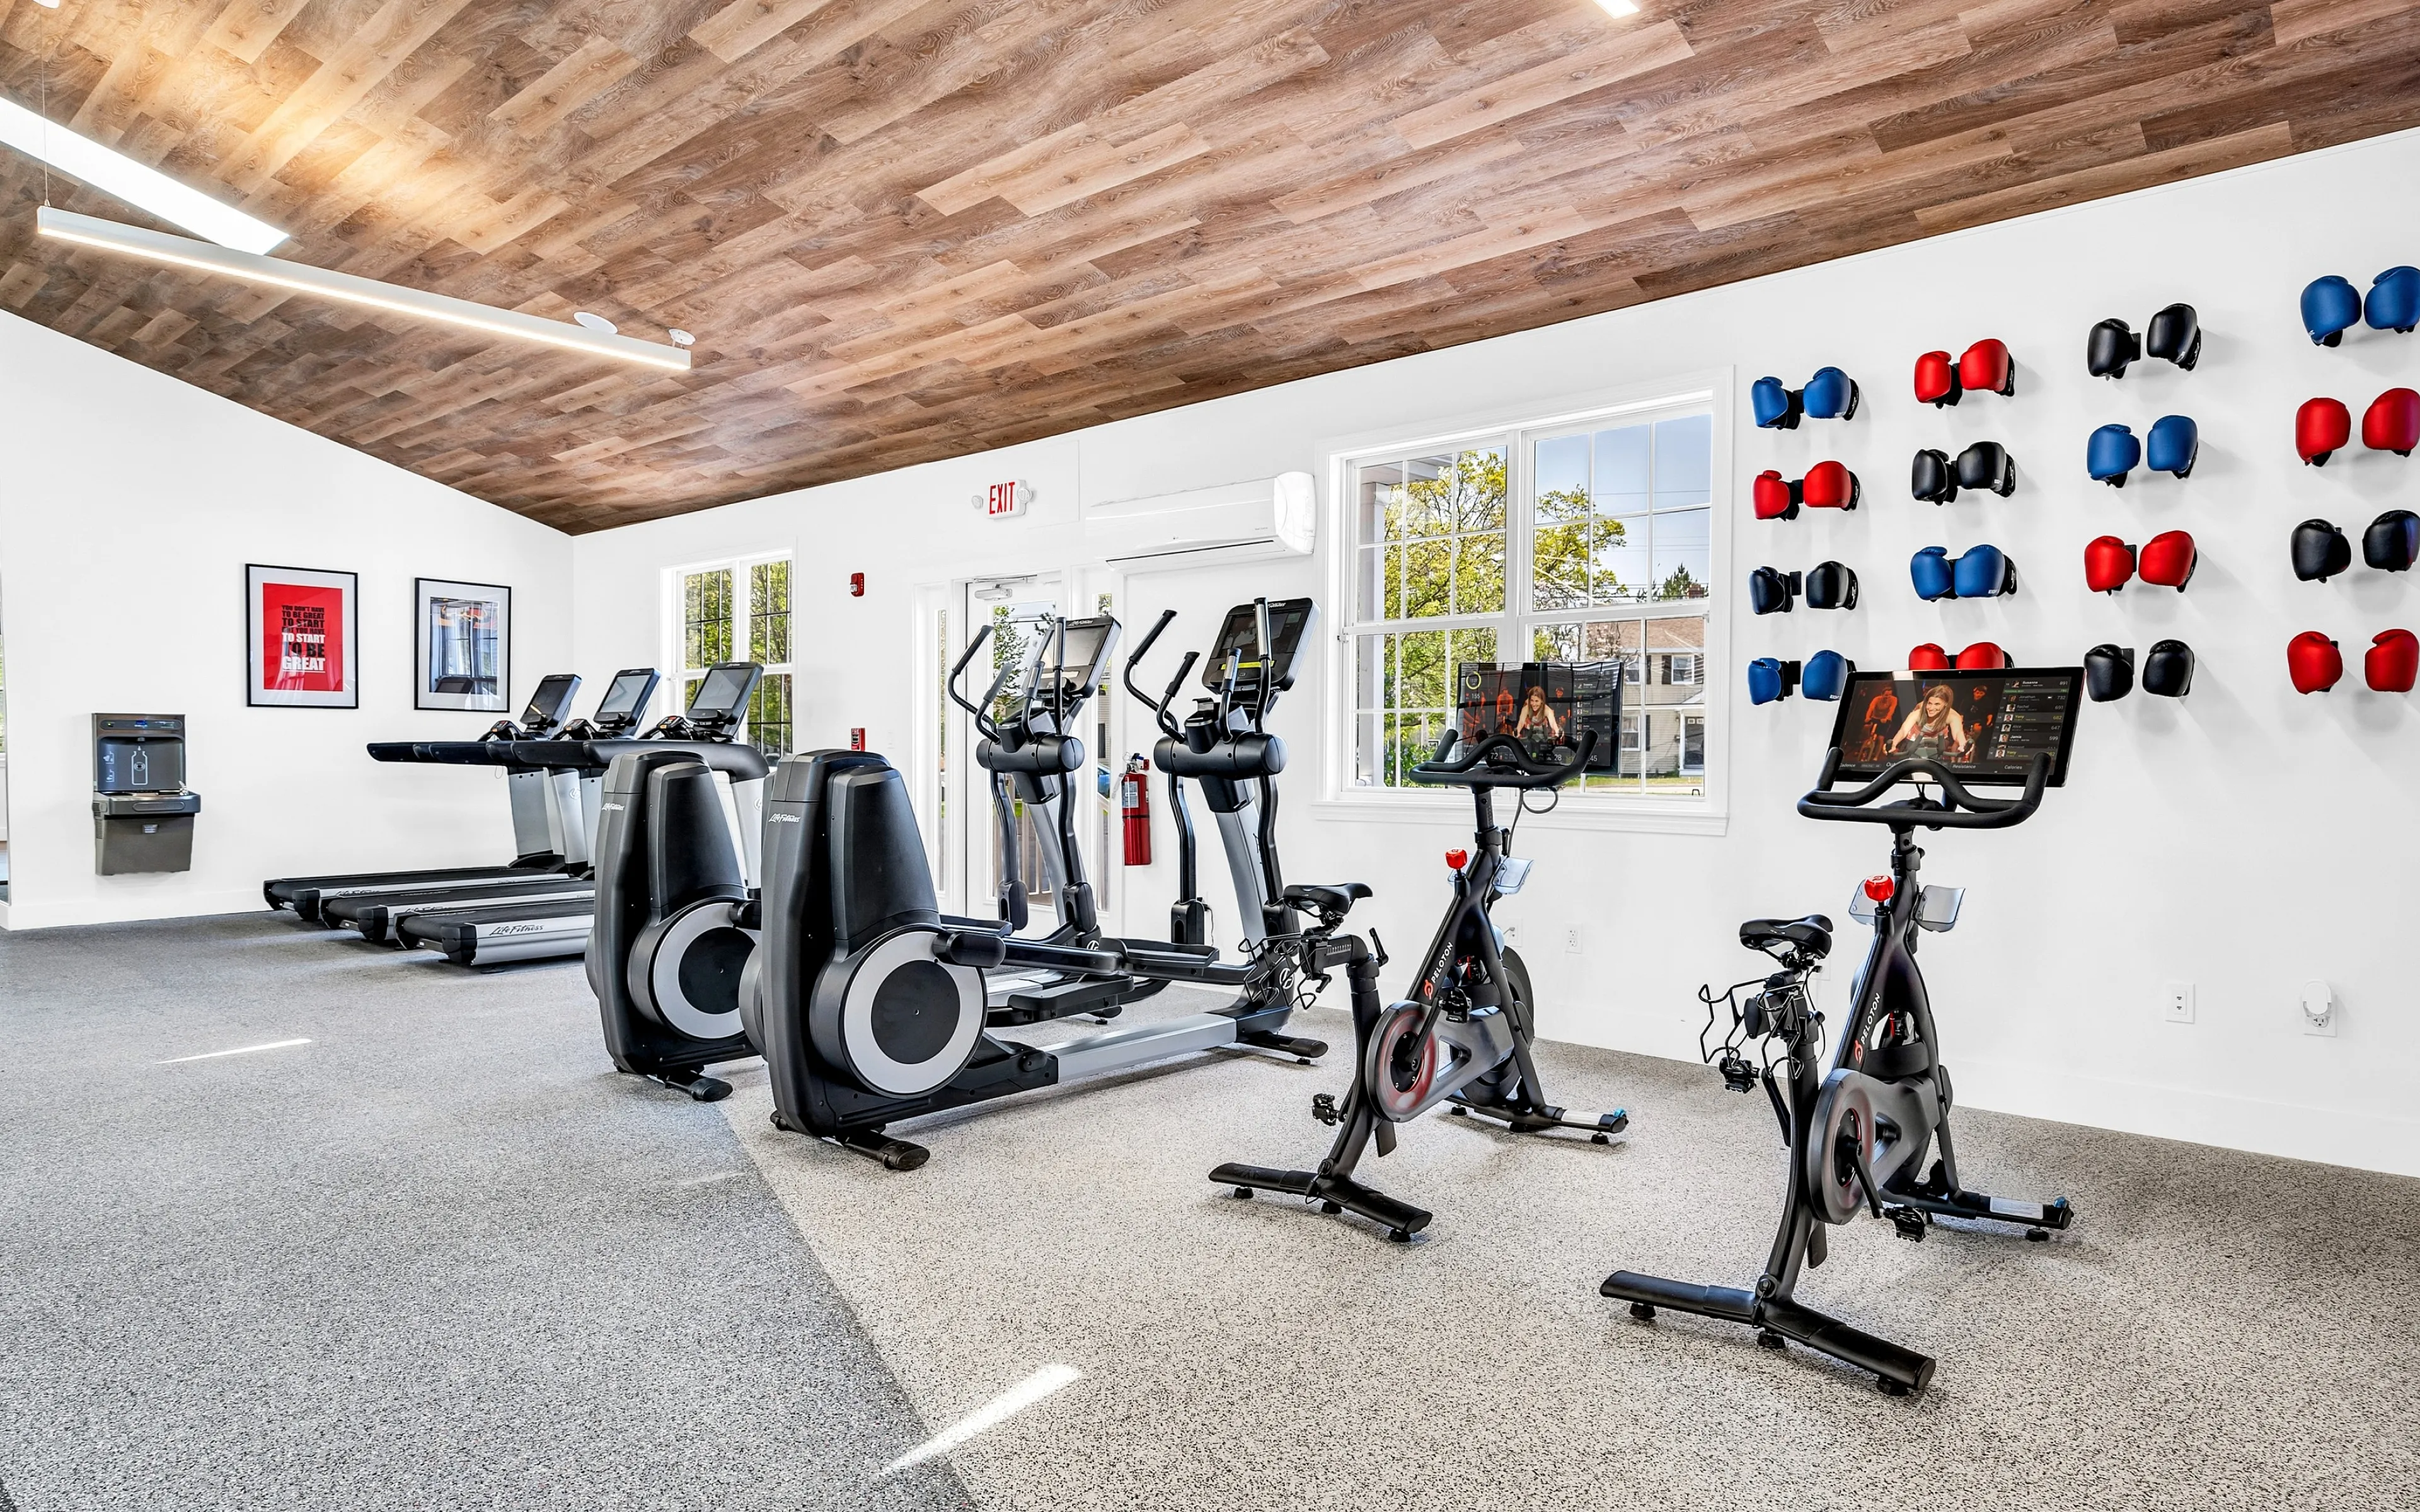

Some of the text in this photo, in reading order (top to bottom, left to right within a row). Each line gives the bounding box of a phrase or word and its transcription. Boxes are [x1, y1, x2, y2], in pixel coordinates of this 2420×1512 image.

[989, 482, 1015, 515] EXIT
[282, 618, 325, 628] TO START
[282, 633, 326, 643] TO START
[307, 643, 325, 658] BE
[282, 656, 326, 671] GREAT
[1431, 941, 1453, 983] PELOTON
[1860, 992, 1881, 1045] PELOTON
